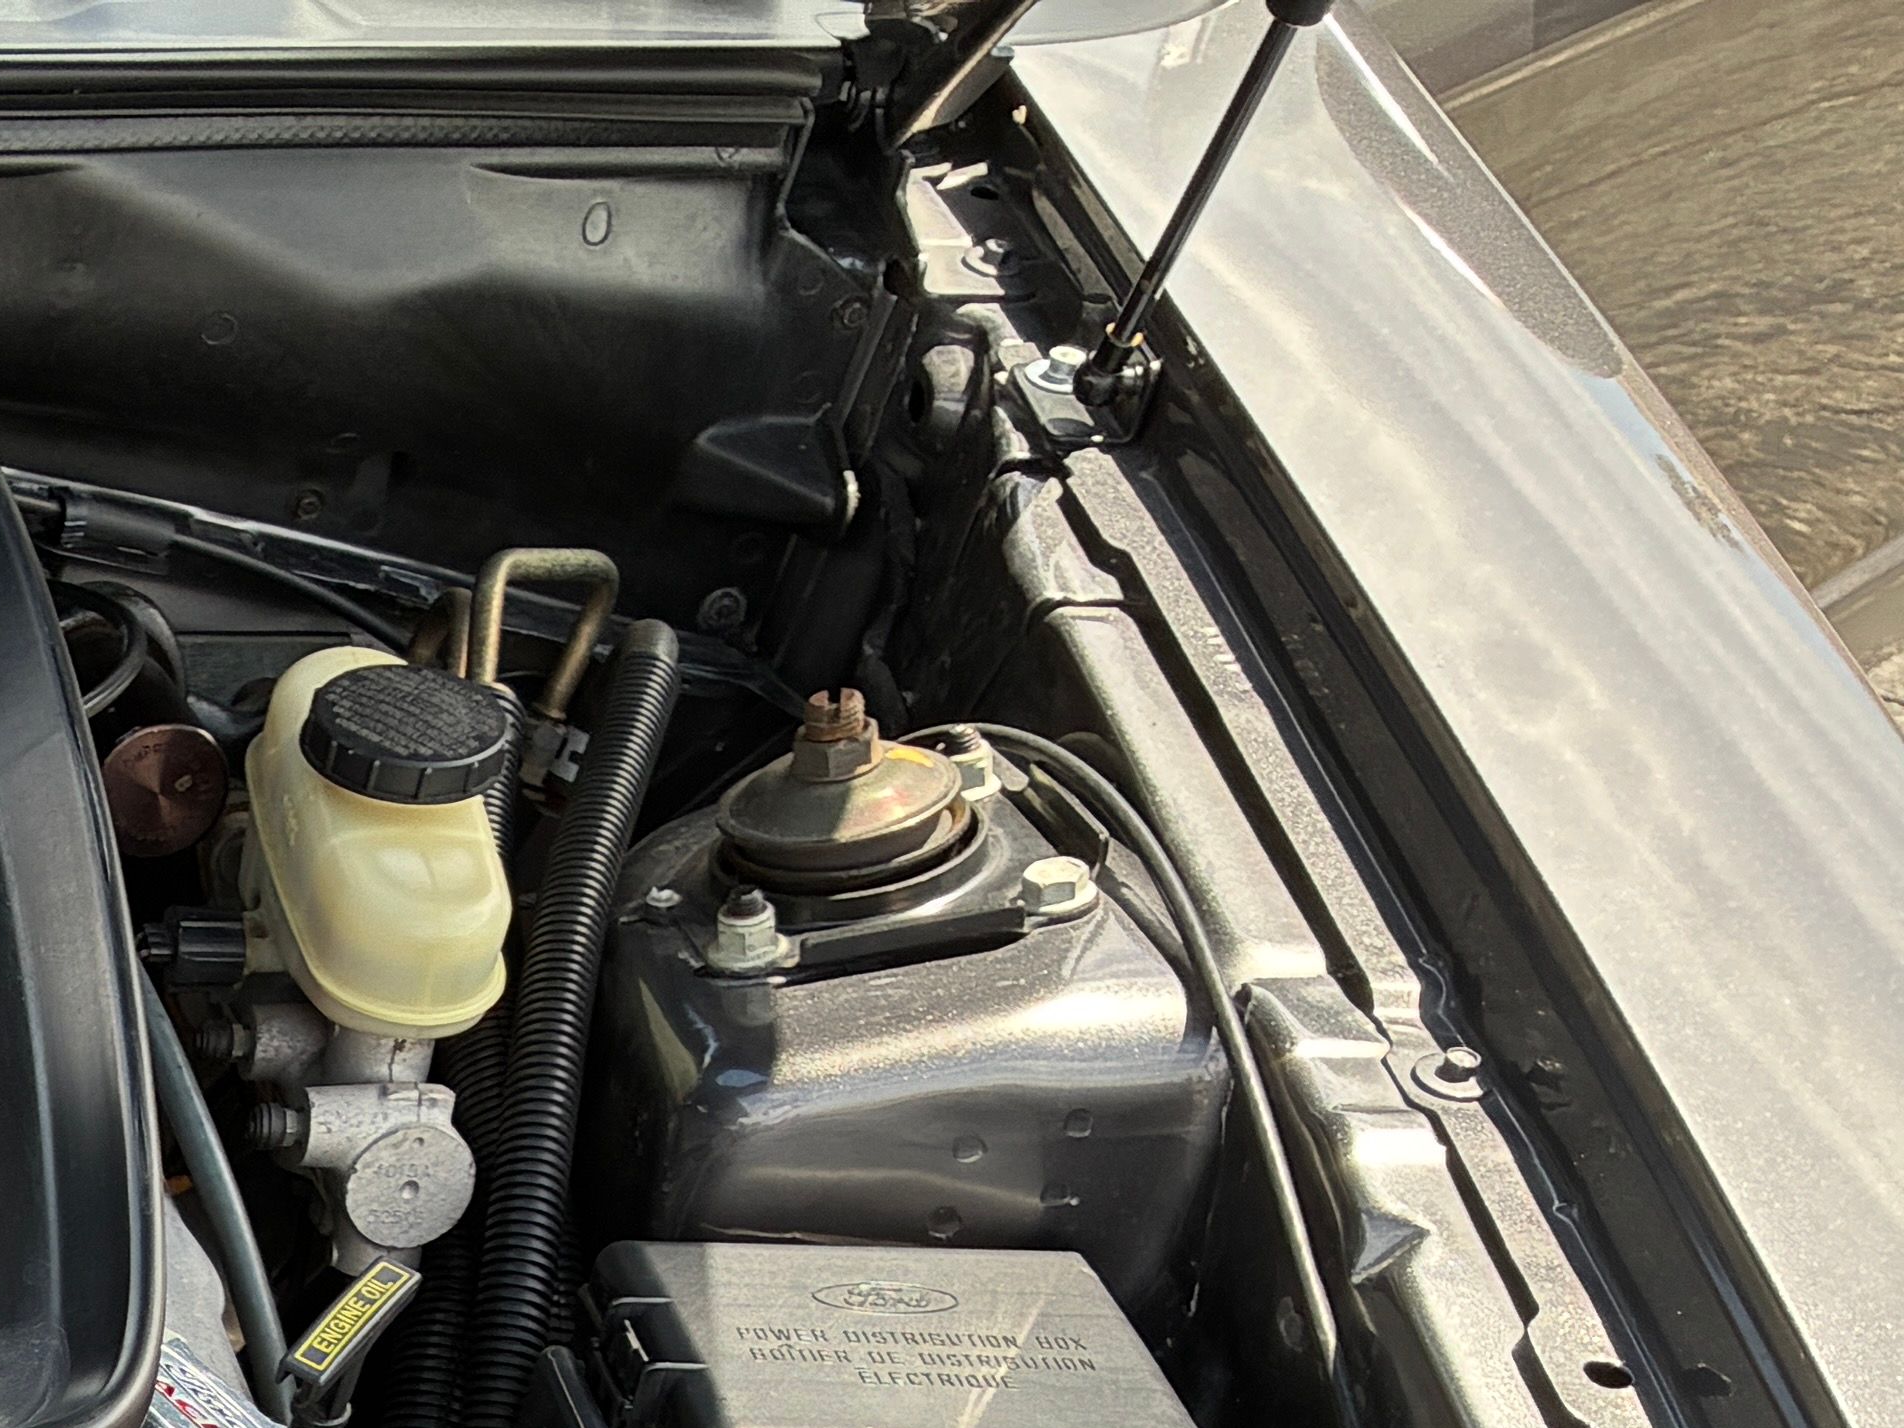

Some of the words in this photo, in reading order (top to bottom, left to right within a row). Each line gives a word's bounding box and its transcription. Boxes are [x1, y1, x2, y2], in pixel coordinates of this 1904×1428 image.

[313, 1296, 370, 1353] ENGINE
[362, 1279, 394, 1306] OIL
[737, 1326, 829, 1342] POWER
[843, 1329, 1020, 1349] DISTRIBUTION
[1035, 1336, 1087, 1351] BOX
[867, 1351, 913, 1365] DE
[920, 1353, 1097, 1371] DISTRIBUTION
